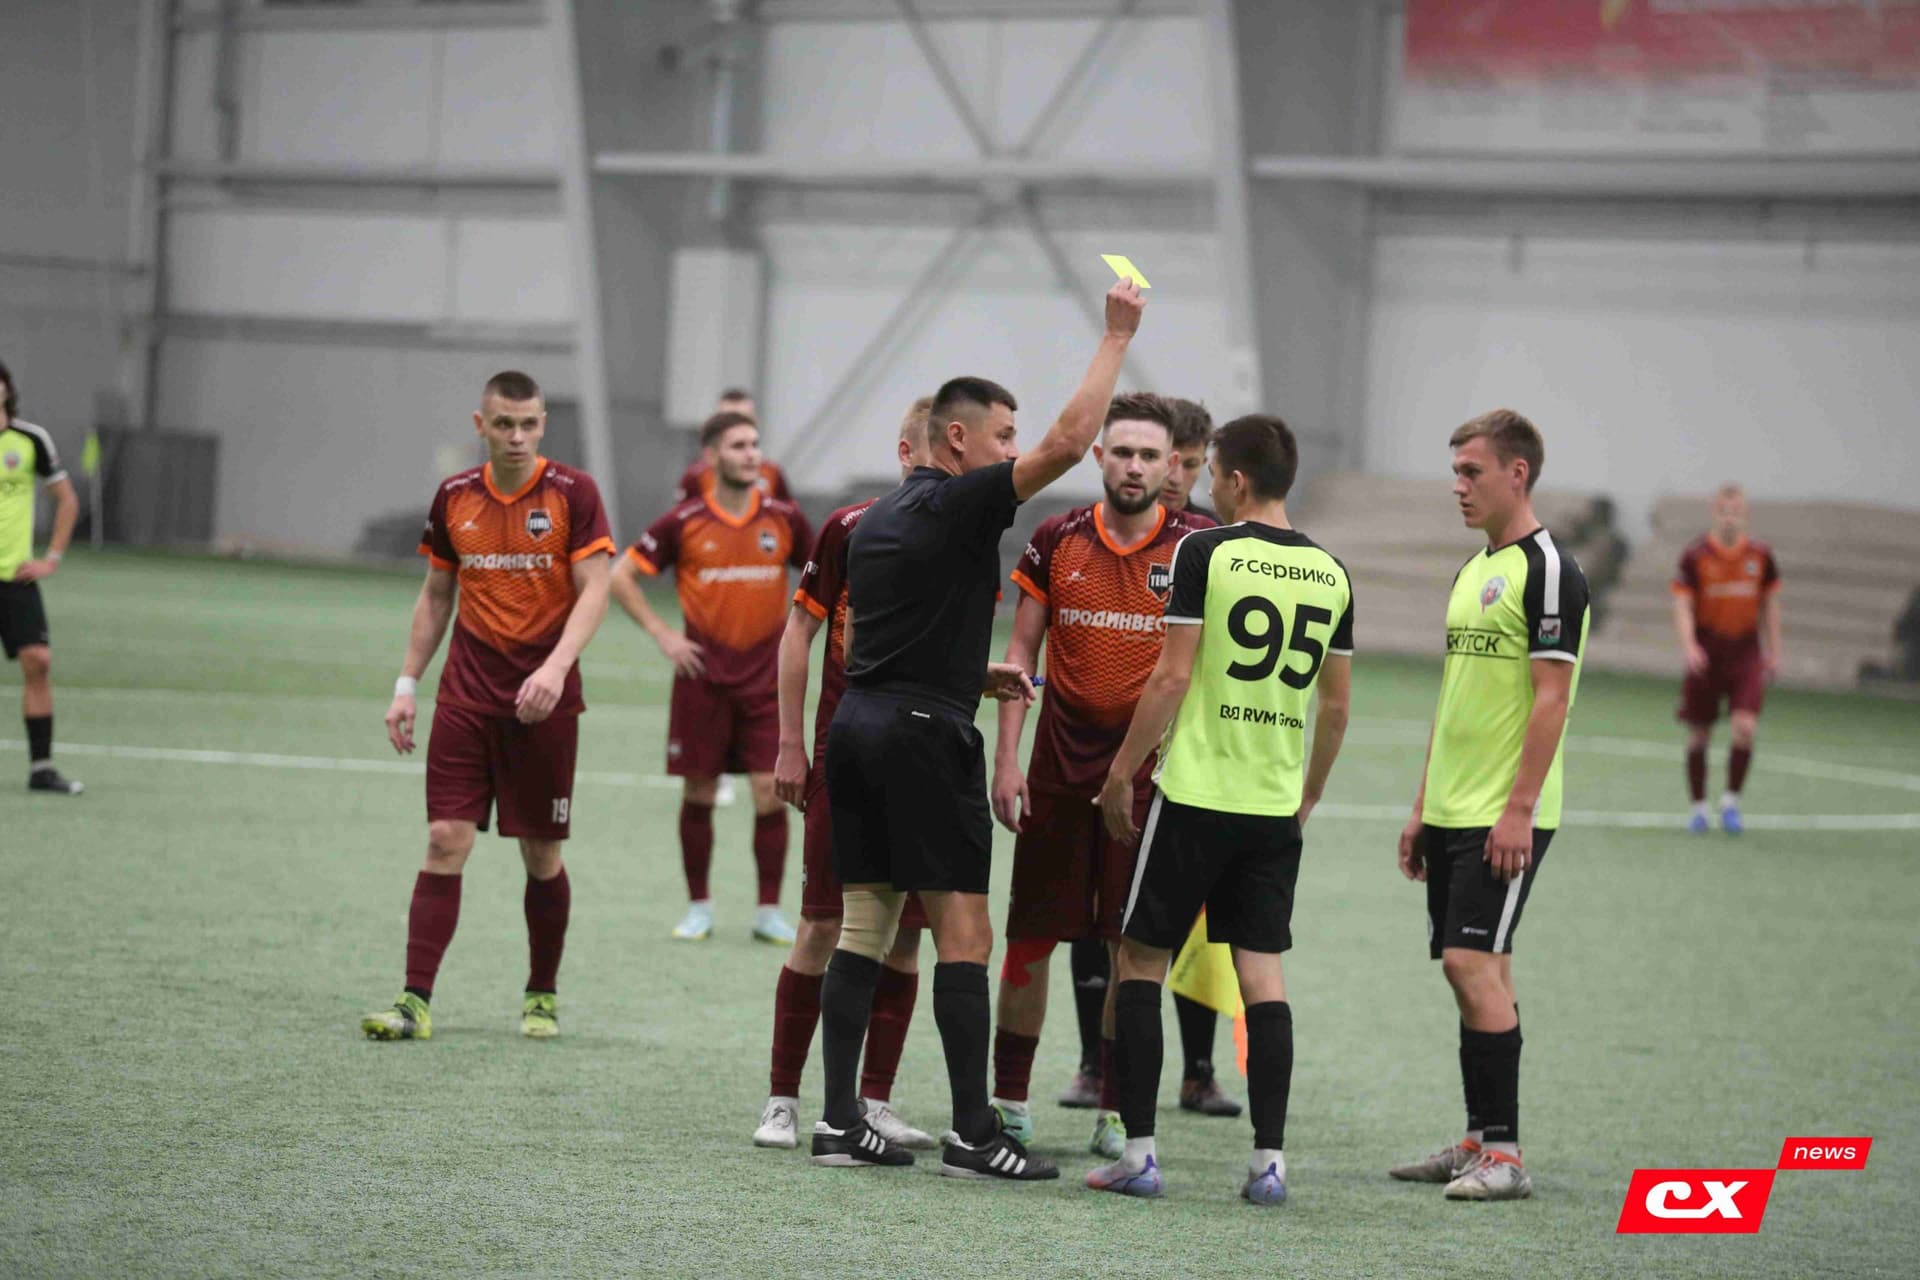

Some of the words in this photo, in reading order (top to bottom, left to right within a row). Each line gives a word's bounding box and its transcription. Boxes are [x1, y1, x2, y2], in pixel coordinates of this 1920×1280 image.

[1150, 574, 1169, 587] ТЕМ
[1059, 607, 1167, 632] ПРОДИНВЕС
[1226, 595, 1332, 690] 95
[1243, 707, 1277, 726] RVM
[1278, 712, 1304, 729] Grou
[552, 798, 569, 823] 19
